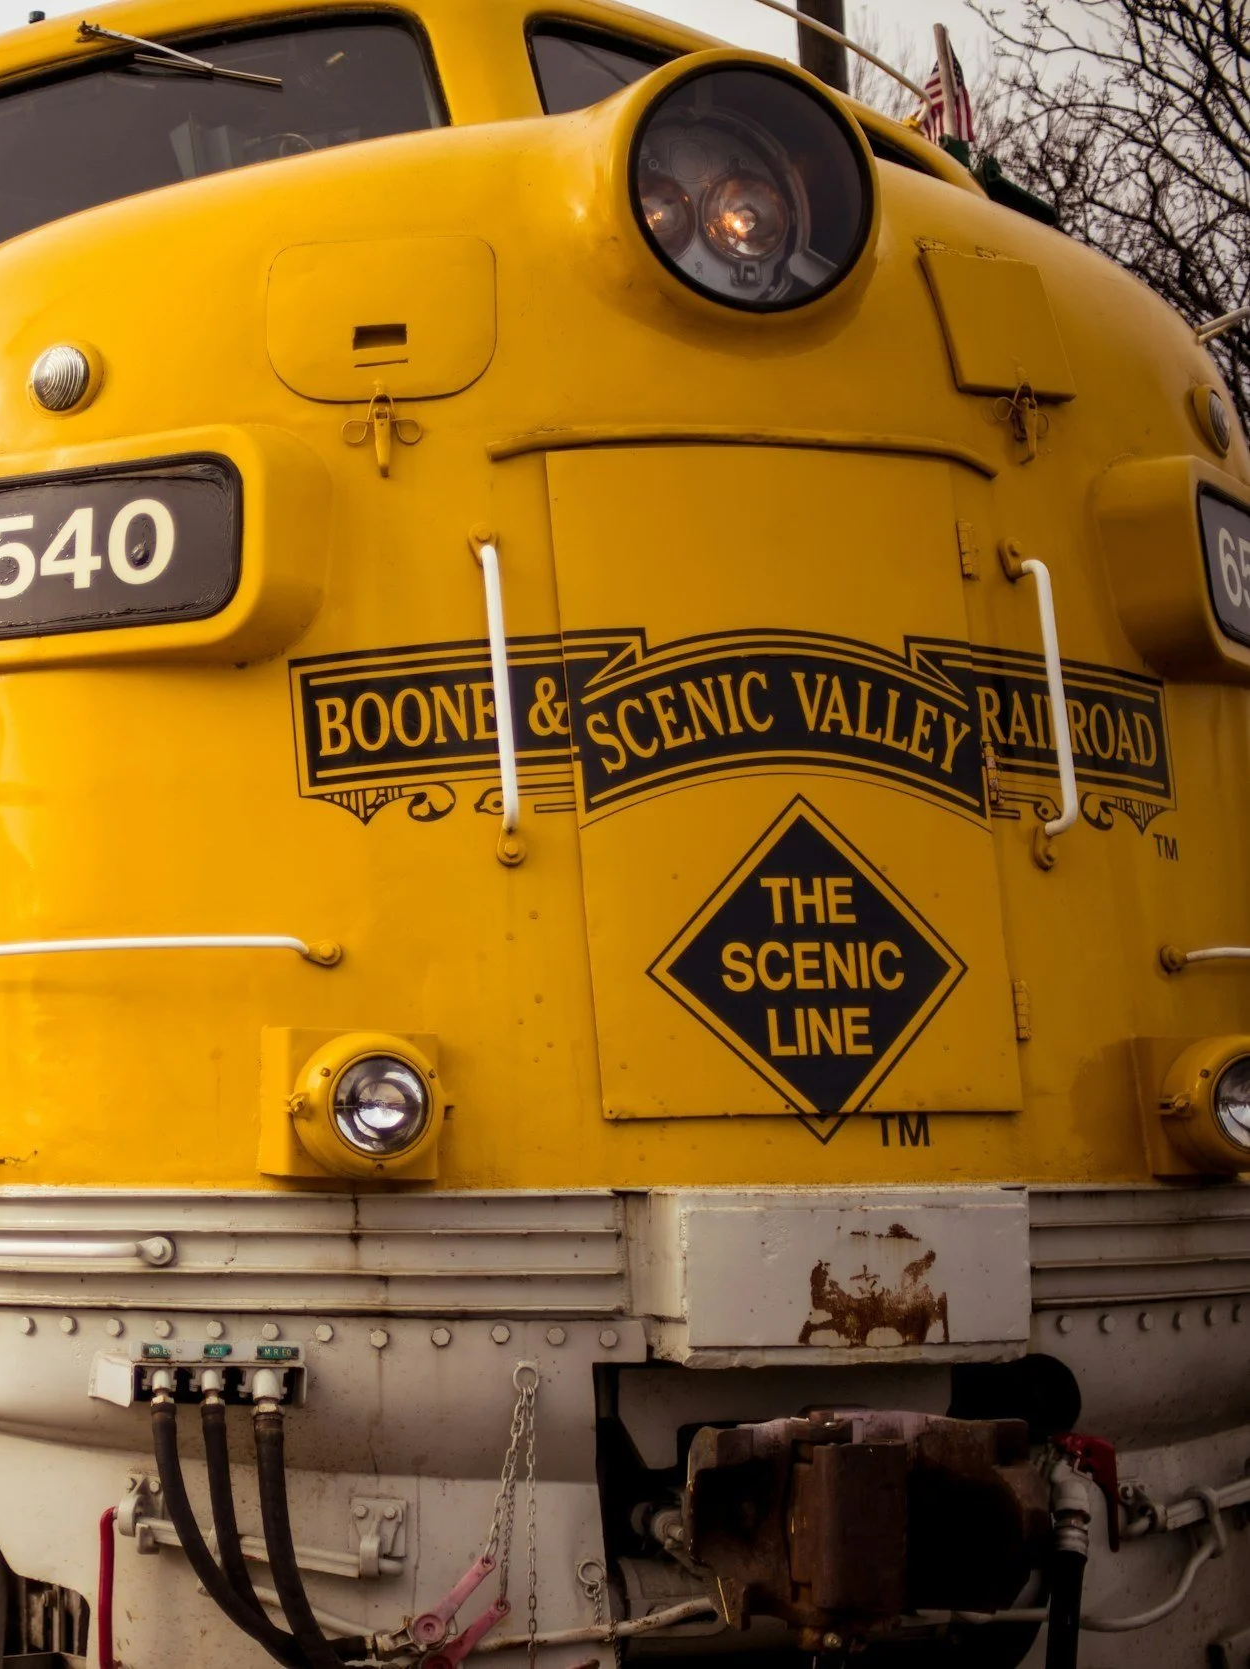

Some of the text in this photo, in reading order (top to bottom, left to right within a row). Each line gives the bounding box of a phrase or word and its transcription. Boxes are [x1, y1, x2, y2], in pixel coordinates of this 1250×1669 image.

[315, 681, 499, 757] BOONE
[528, 676, 570, 736] &
[586, 671, 774, 774] SCENIC
[791, 671, 971, 774] VALLEY
[1153, 833, 1179, 861] TM
[760, 877, 856, 924] THE
[721, 940, 905, 992] SCENIC
[766, 1007, 873, 1056] LINE
[871, 1113, 931, 1147] TM
